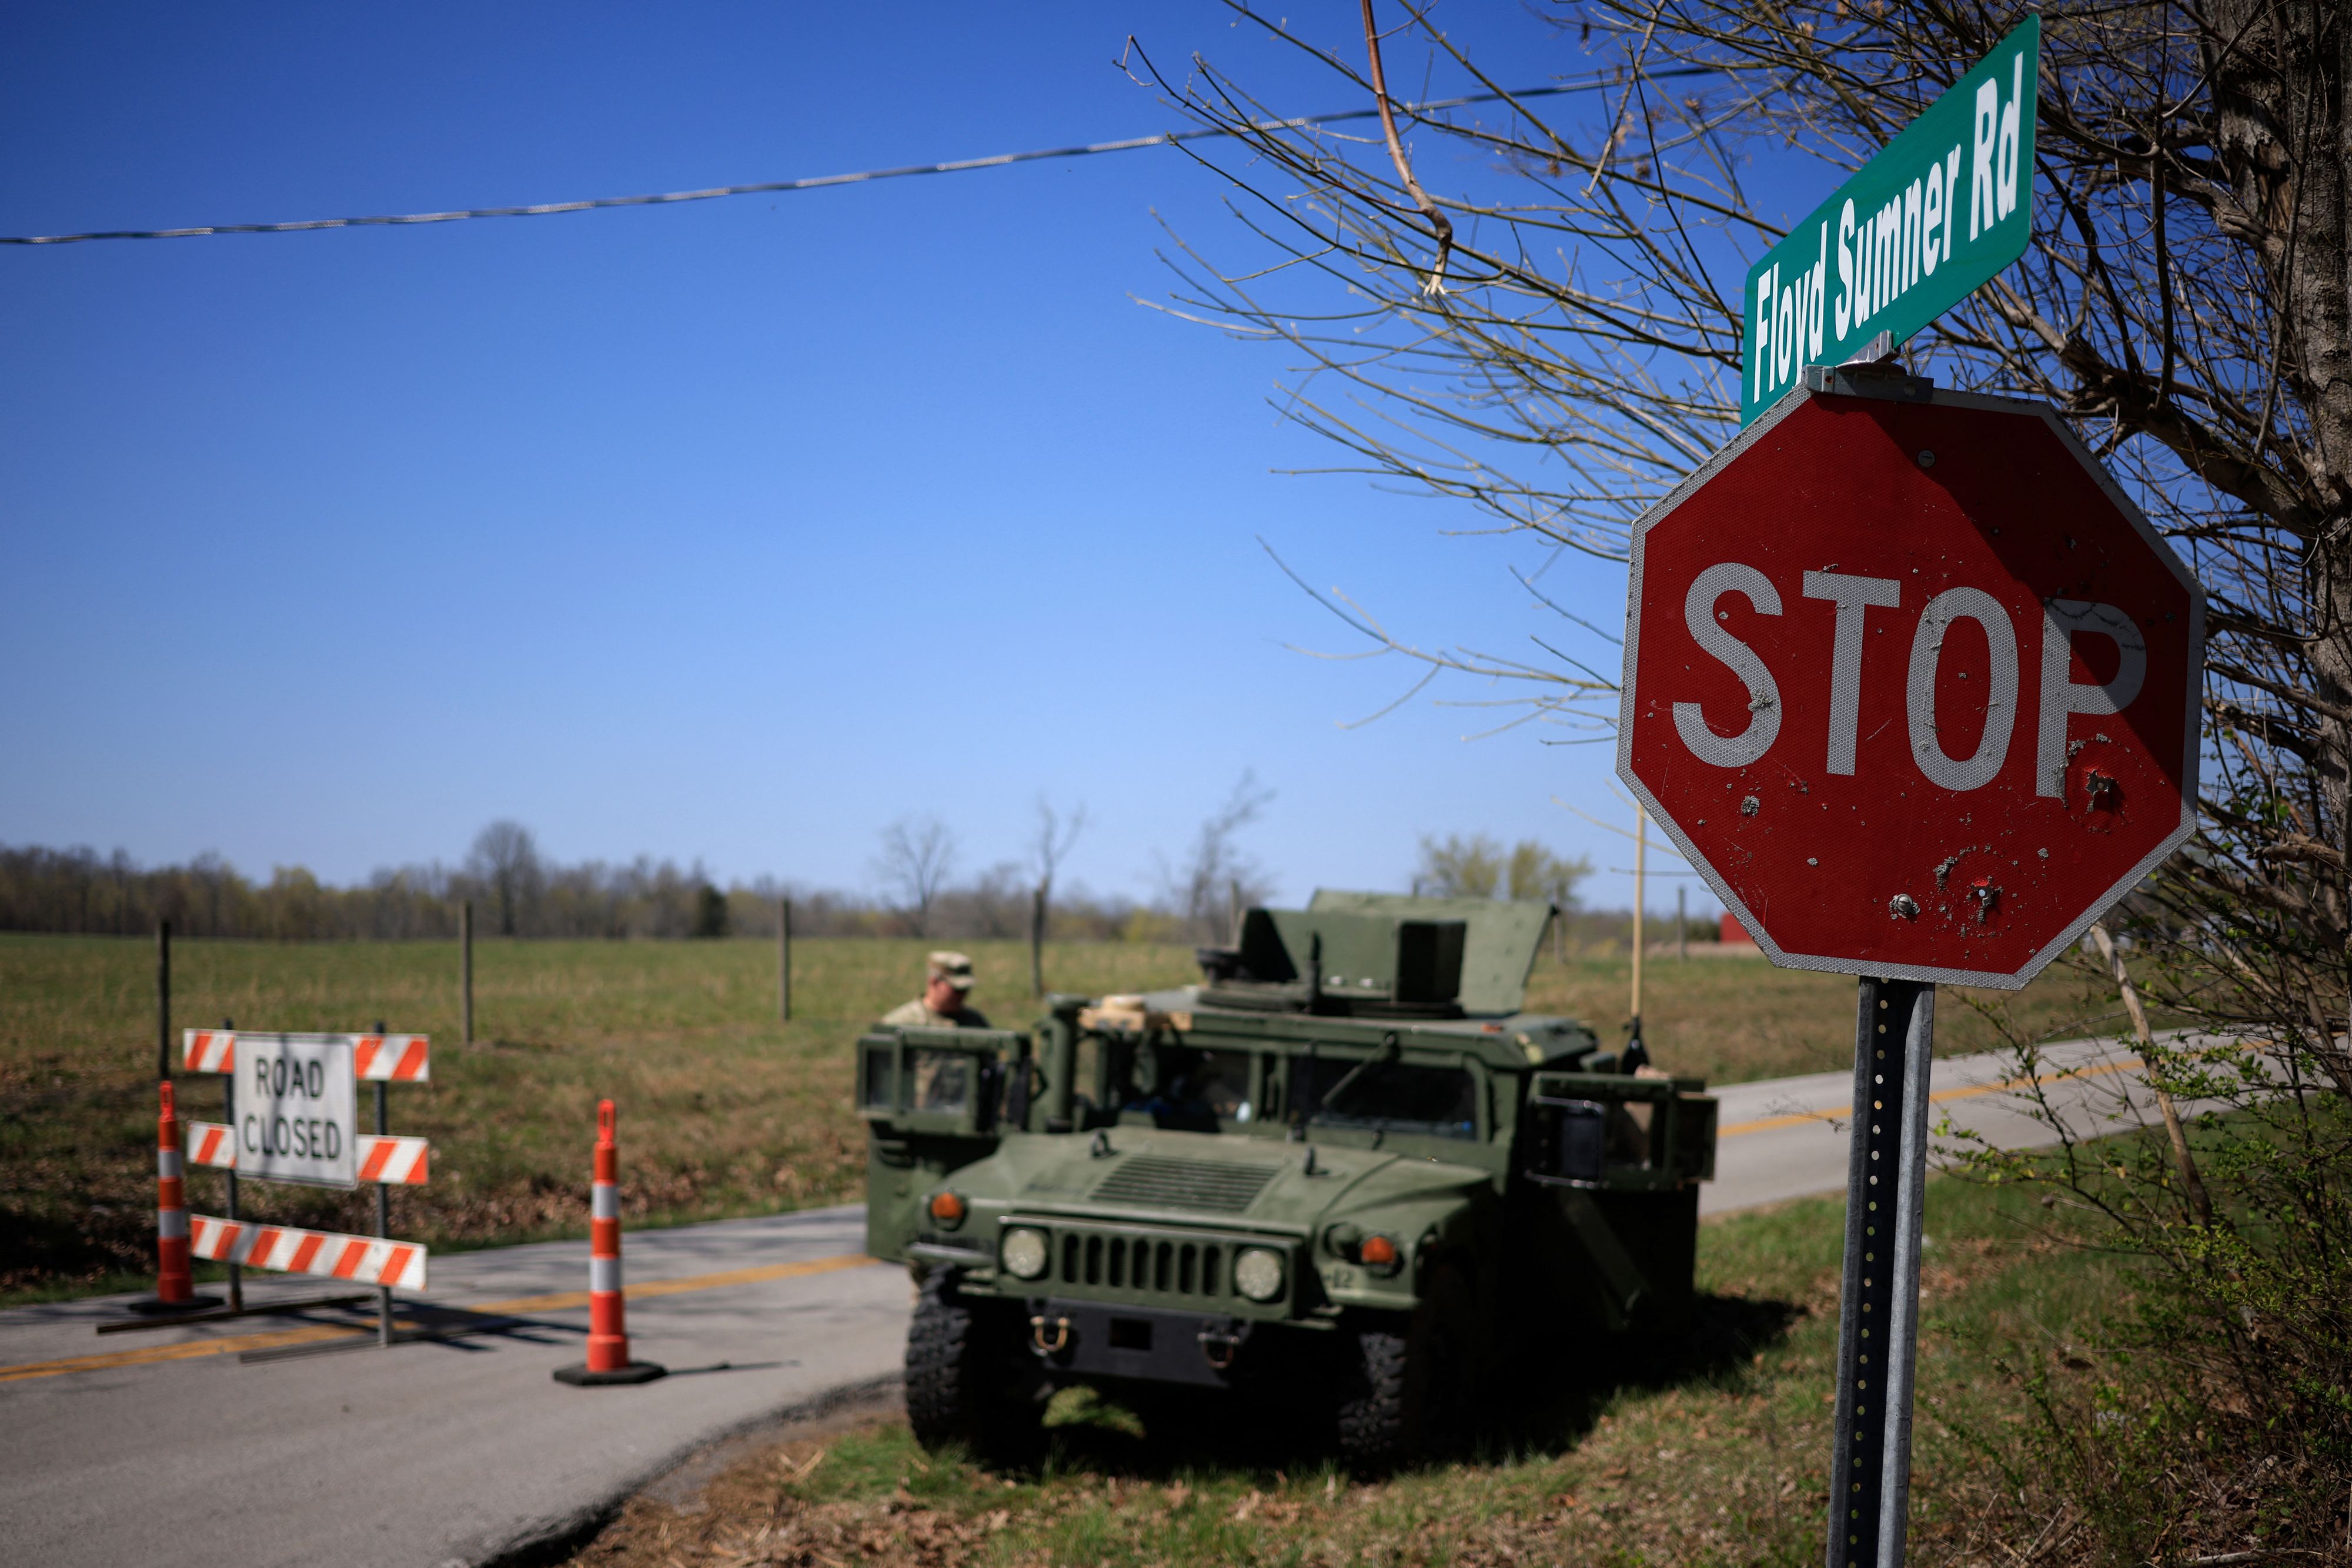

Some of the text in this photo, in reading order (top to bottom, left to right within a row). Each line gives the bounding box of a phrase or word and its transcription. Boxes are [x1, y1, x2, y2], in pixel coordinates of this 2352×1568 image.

[1753, 51, 2023, 404] Floyd Sumner Rd
[1672, 562, 2147, 798] STOP
[243, 1114, 342, 1159] CLOSED
[256, 1058, 324, 1098] ROAD
